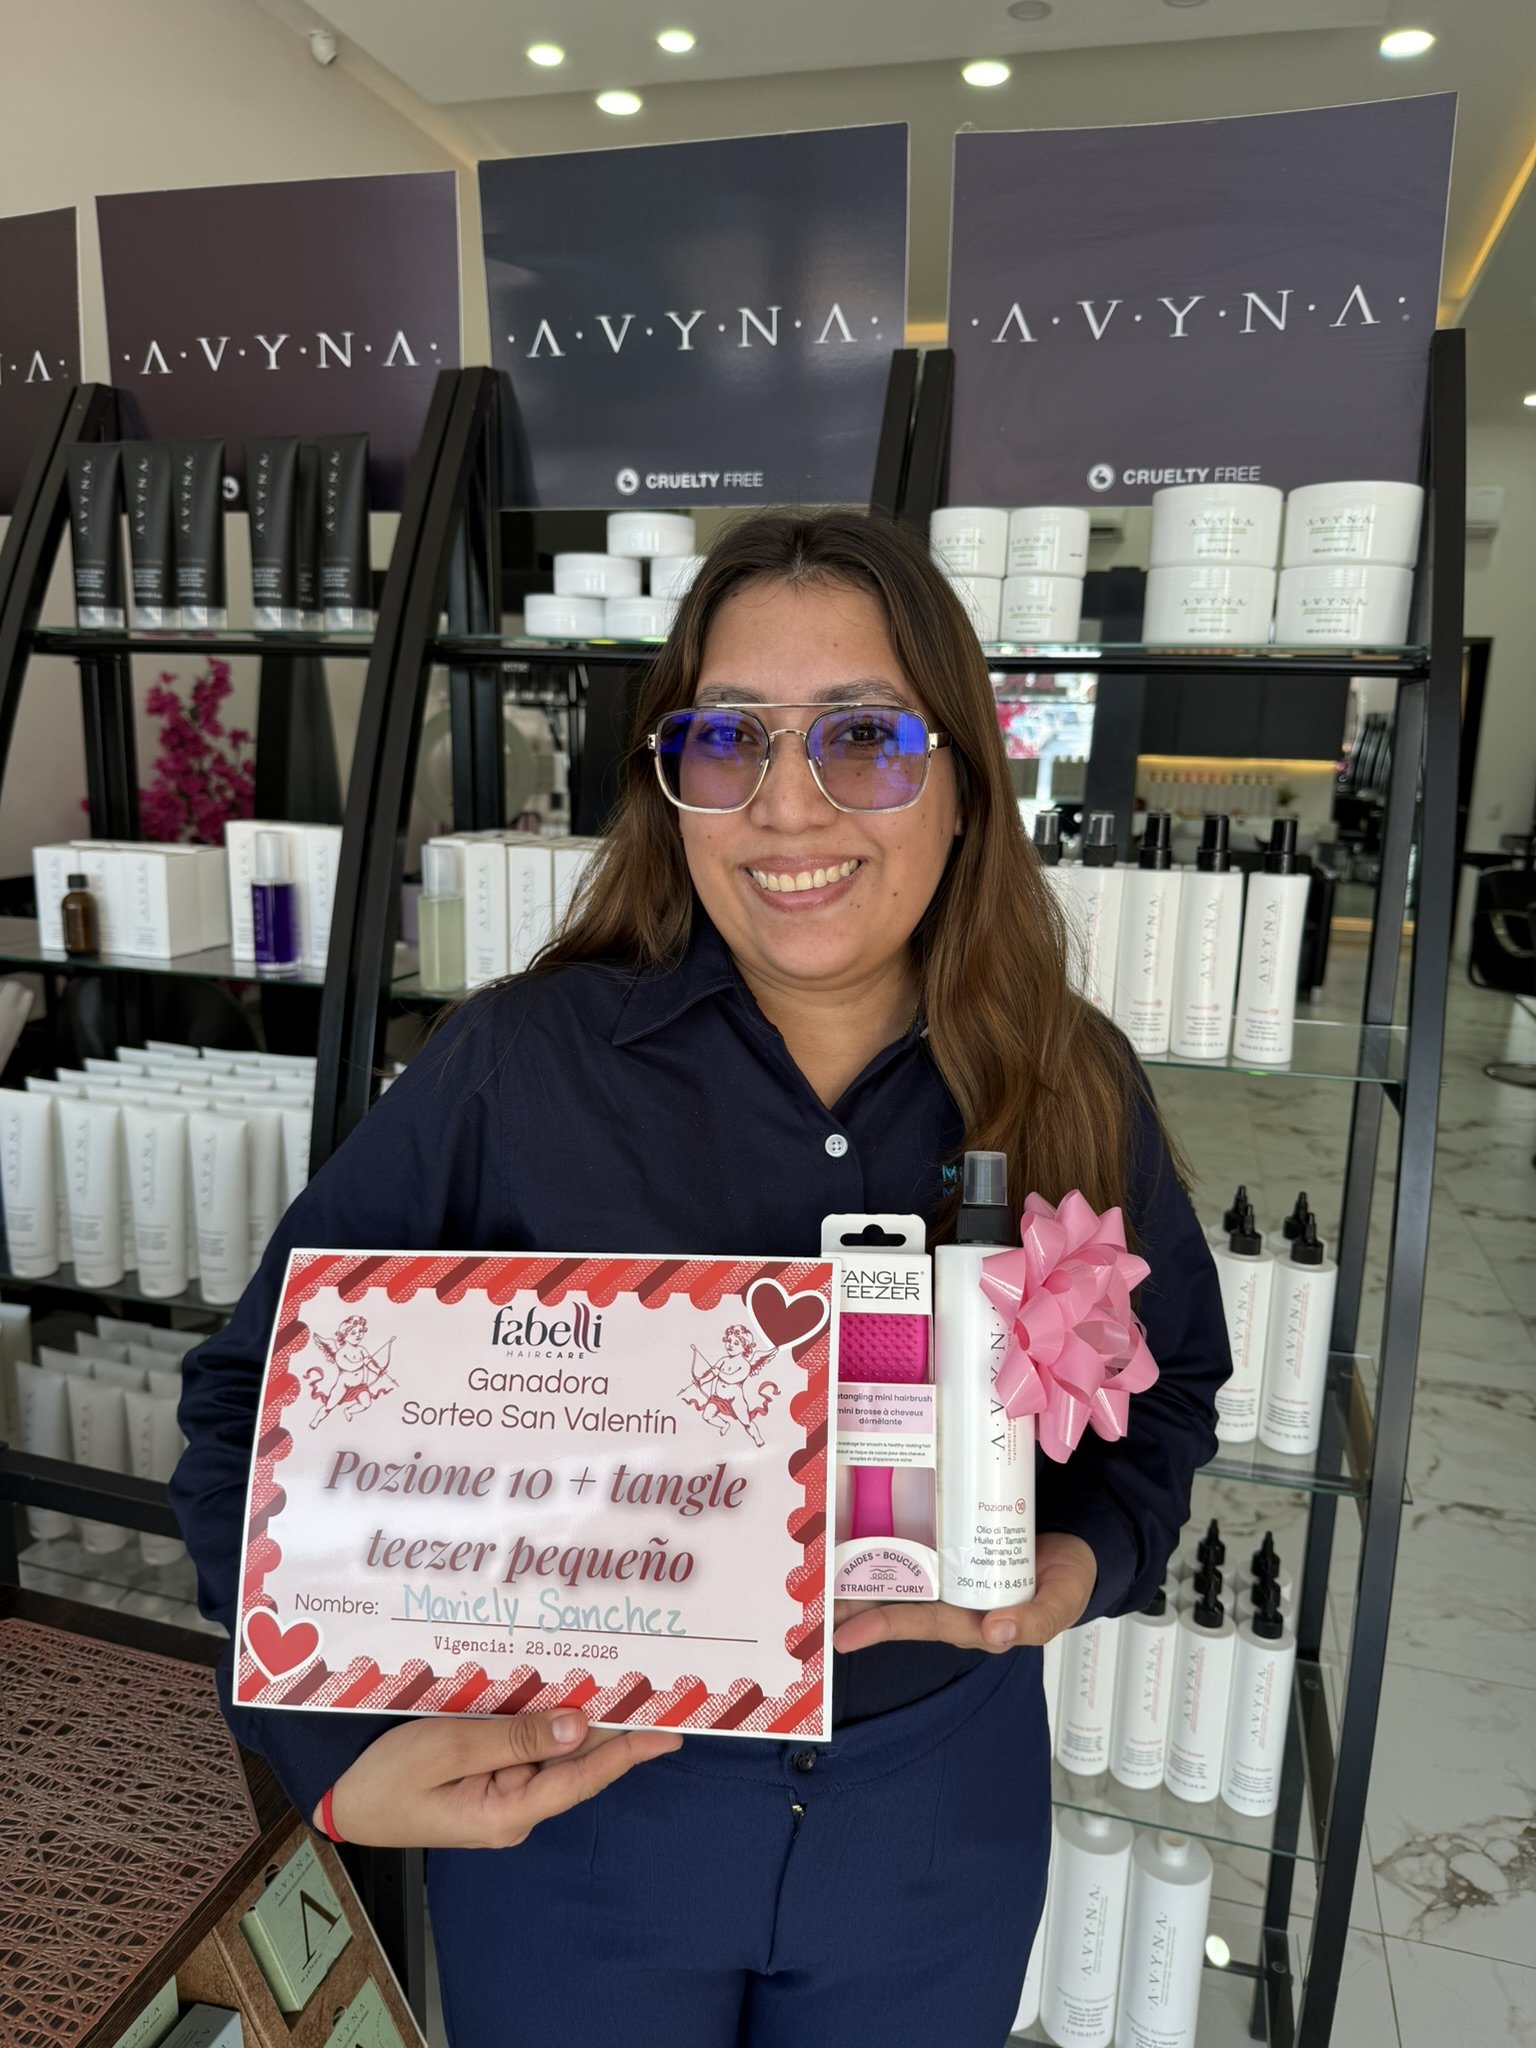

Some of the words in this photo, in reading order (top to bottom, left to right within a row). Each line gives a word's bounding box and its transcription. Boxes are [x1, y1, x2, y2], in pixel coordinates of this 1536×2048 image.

[645, 471, 720, 489] CRUELTY
[723, 470, 764, 488] FREE
[1122, 467, 1210, 486] CRUELTY
[1214, 465, 1262, 482] FREE
[492, 1301, 603, 1354] fabelli
[467, 1368, 609, 1396] Ganadora
[894, 1394, 933, 1402] hairbrush
[401, 1401, 493, 1429] Sorteo
[501, 1404, 556, 1430] San
[564, 1407, 677, 1435] Valentín
[890, 1408, 924, 1416] cheveux
[323, 1450, 496, 1497] Pozione
[508, 1467, 554, 1500] 10
[569, 1466, 597, 1495] +
[609, 1462, 748, 1517] tangle
[978, 1501, 1013, 1512] Pozione
[976, 1525, 992, 1534] Olio
[994, 1526, 1001, 1534] di
[974, 1536, 994, 1545] Huile
[366, 1529, 497, 1573] teezer
[501, 1535, 694, 1587] pequeño
[984, 1547, 1012, 1555] Tamanu
[844, 1552, 874, 1576] RAIDES
[883, 1551, 922, 1577] BOUCLÉS
[970, 1557, 995, 1566] Aceite
[840, 1583, 885, 1592] STRAIGHT
[895, 1585, 924, 1593] CURLY
[957, 1576, 974, 1587] 250
[976, 1580, 991, 1589] mL
[1004, 1579, 1021, 1589] 8.45
[295, 1593, 379, 1616] Nombre:
[538, 1587, 688, 1636] Sanchez
[434, 1635, 515, 1656] Vigencia:
[526, 1640, 619, 1660] 28.02.2026
